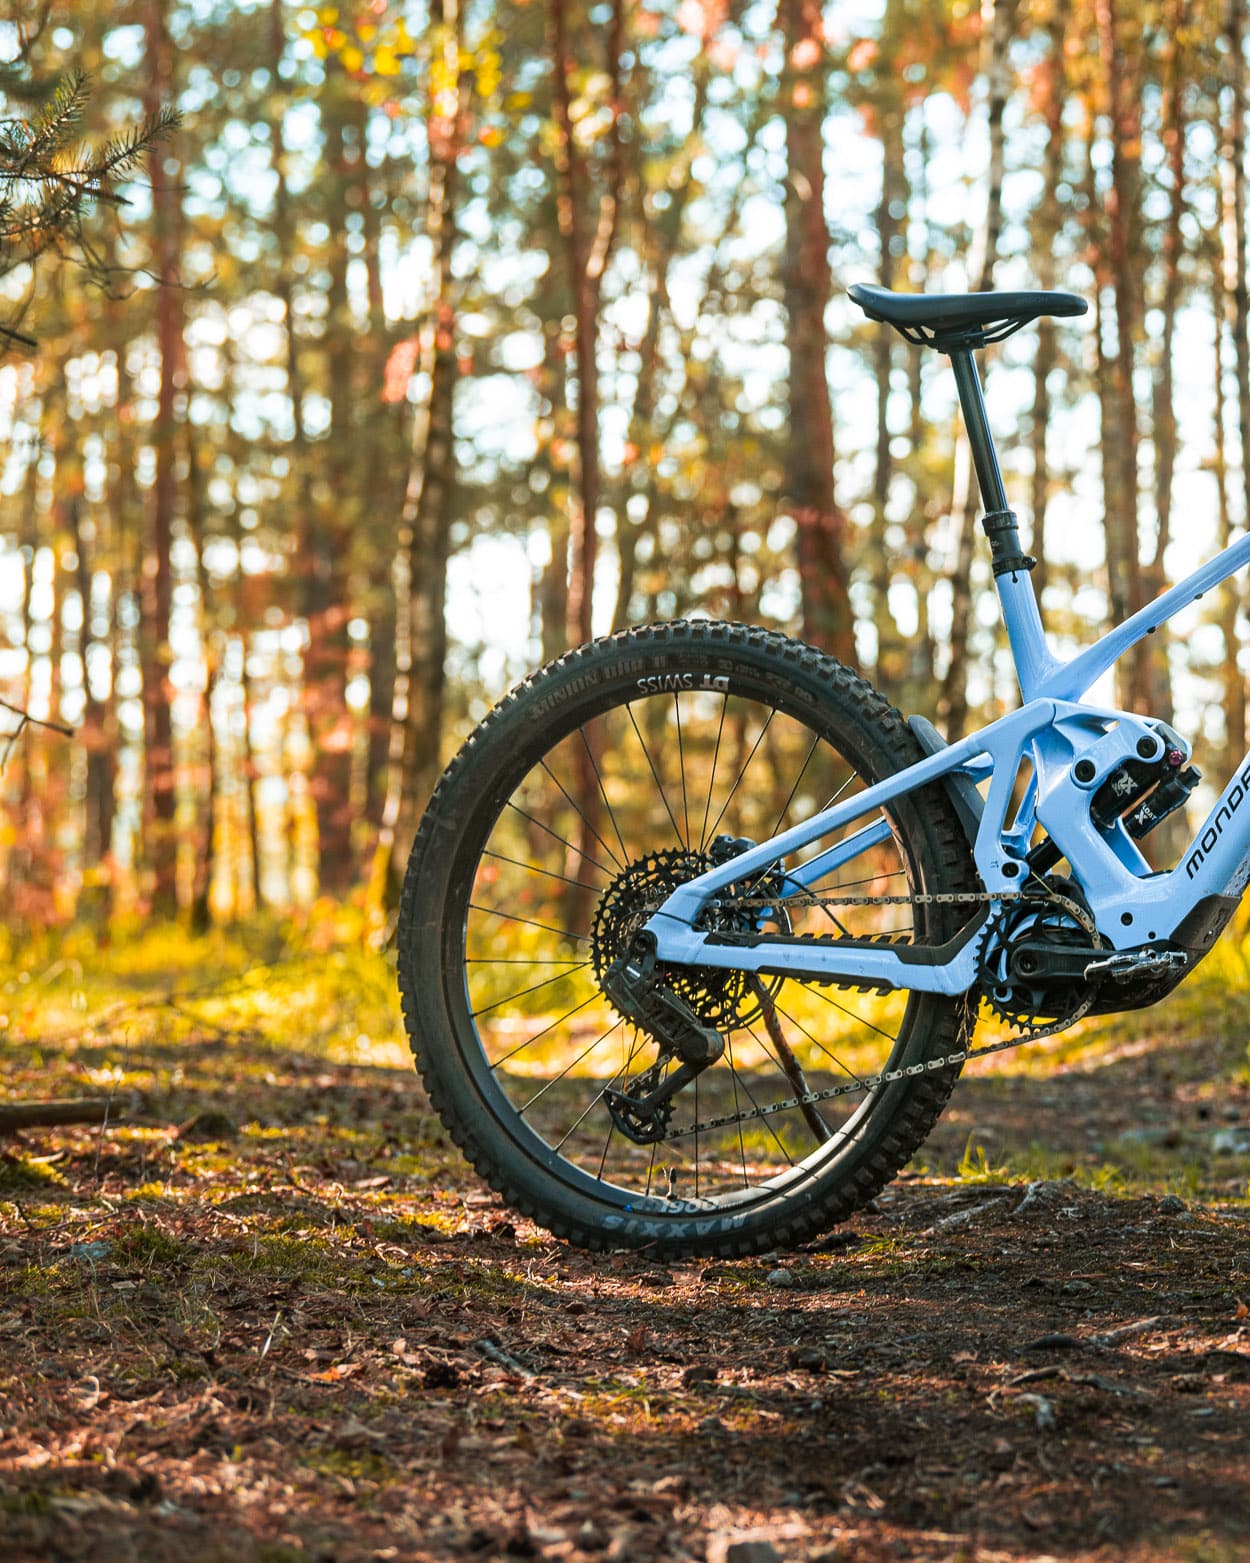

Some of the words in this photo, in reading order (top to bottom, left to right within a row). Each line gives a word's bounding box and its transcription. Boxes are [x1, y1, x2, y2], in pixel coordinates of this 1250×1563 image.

[637, 673, 693, 694] SWISS
[700, 674, 730, 691] DT
[601, 1212, 748, 1238] MAXXIS
